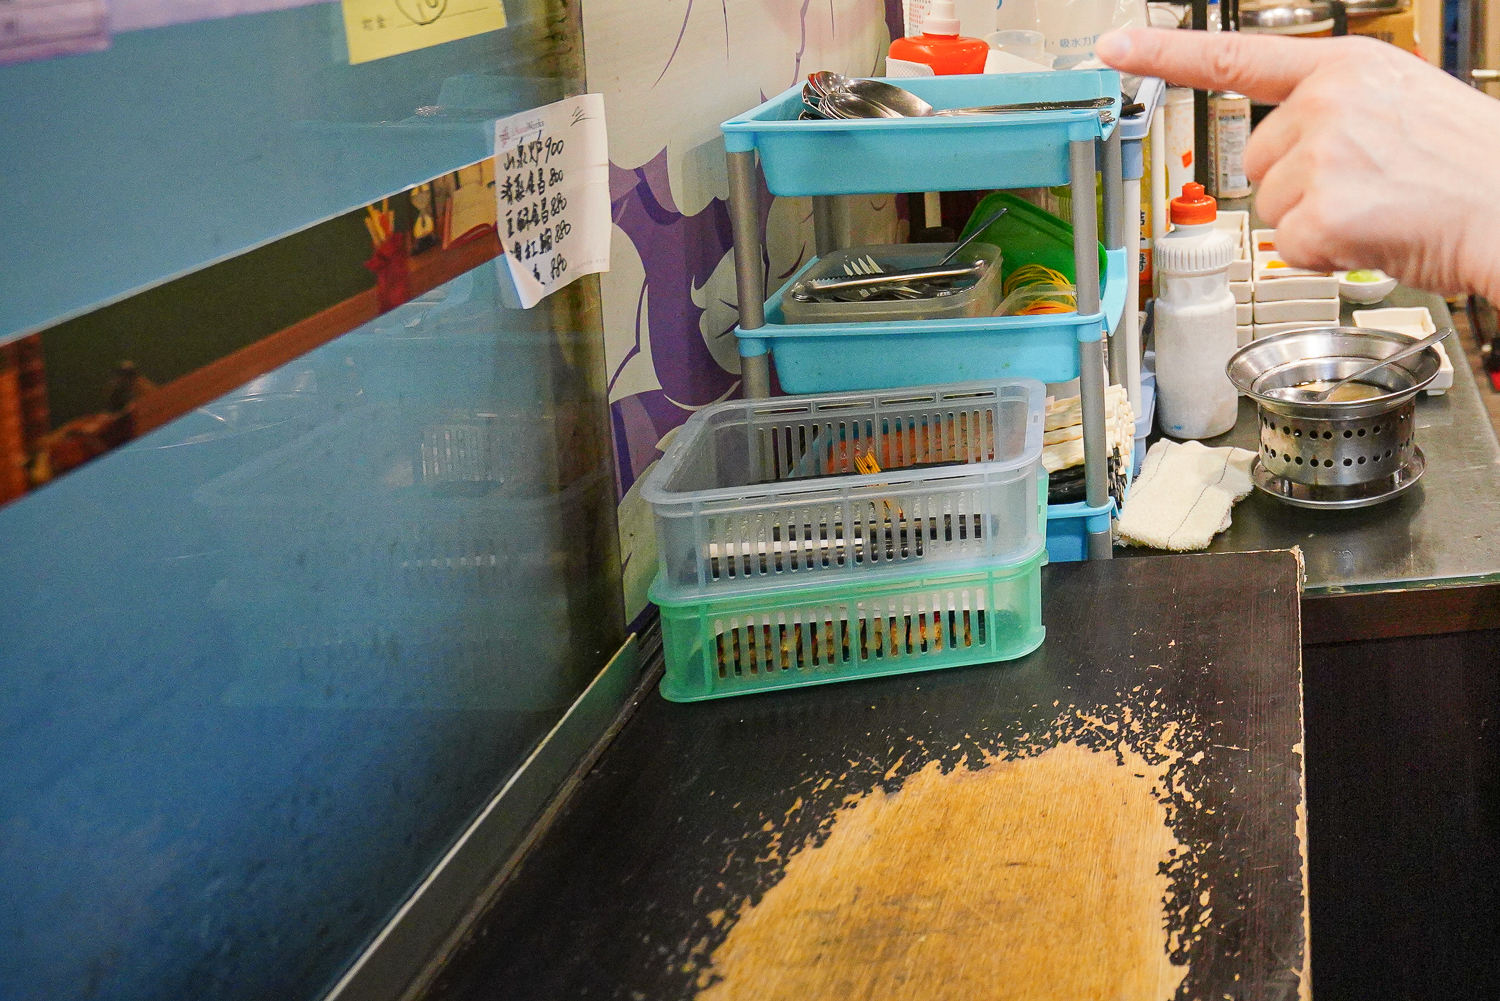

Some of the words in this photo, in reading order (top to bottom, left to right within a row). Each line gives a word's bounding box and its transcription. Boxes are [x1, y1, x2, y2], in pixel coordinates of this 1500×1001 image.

[545, 136, 564, 164] 900
[548, 168, 564, 187] 800
[551, 192, 567, 217] 880
[555, 219, 571, 244] 880
